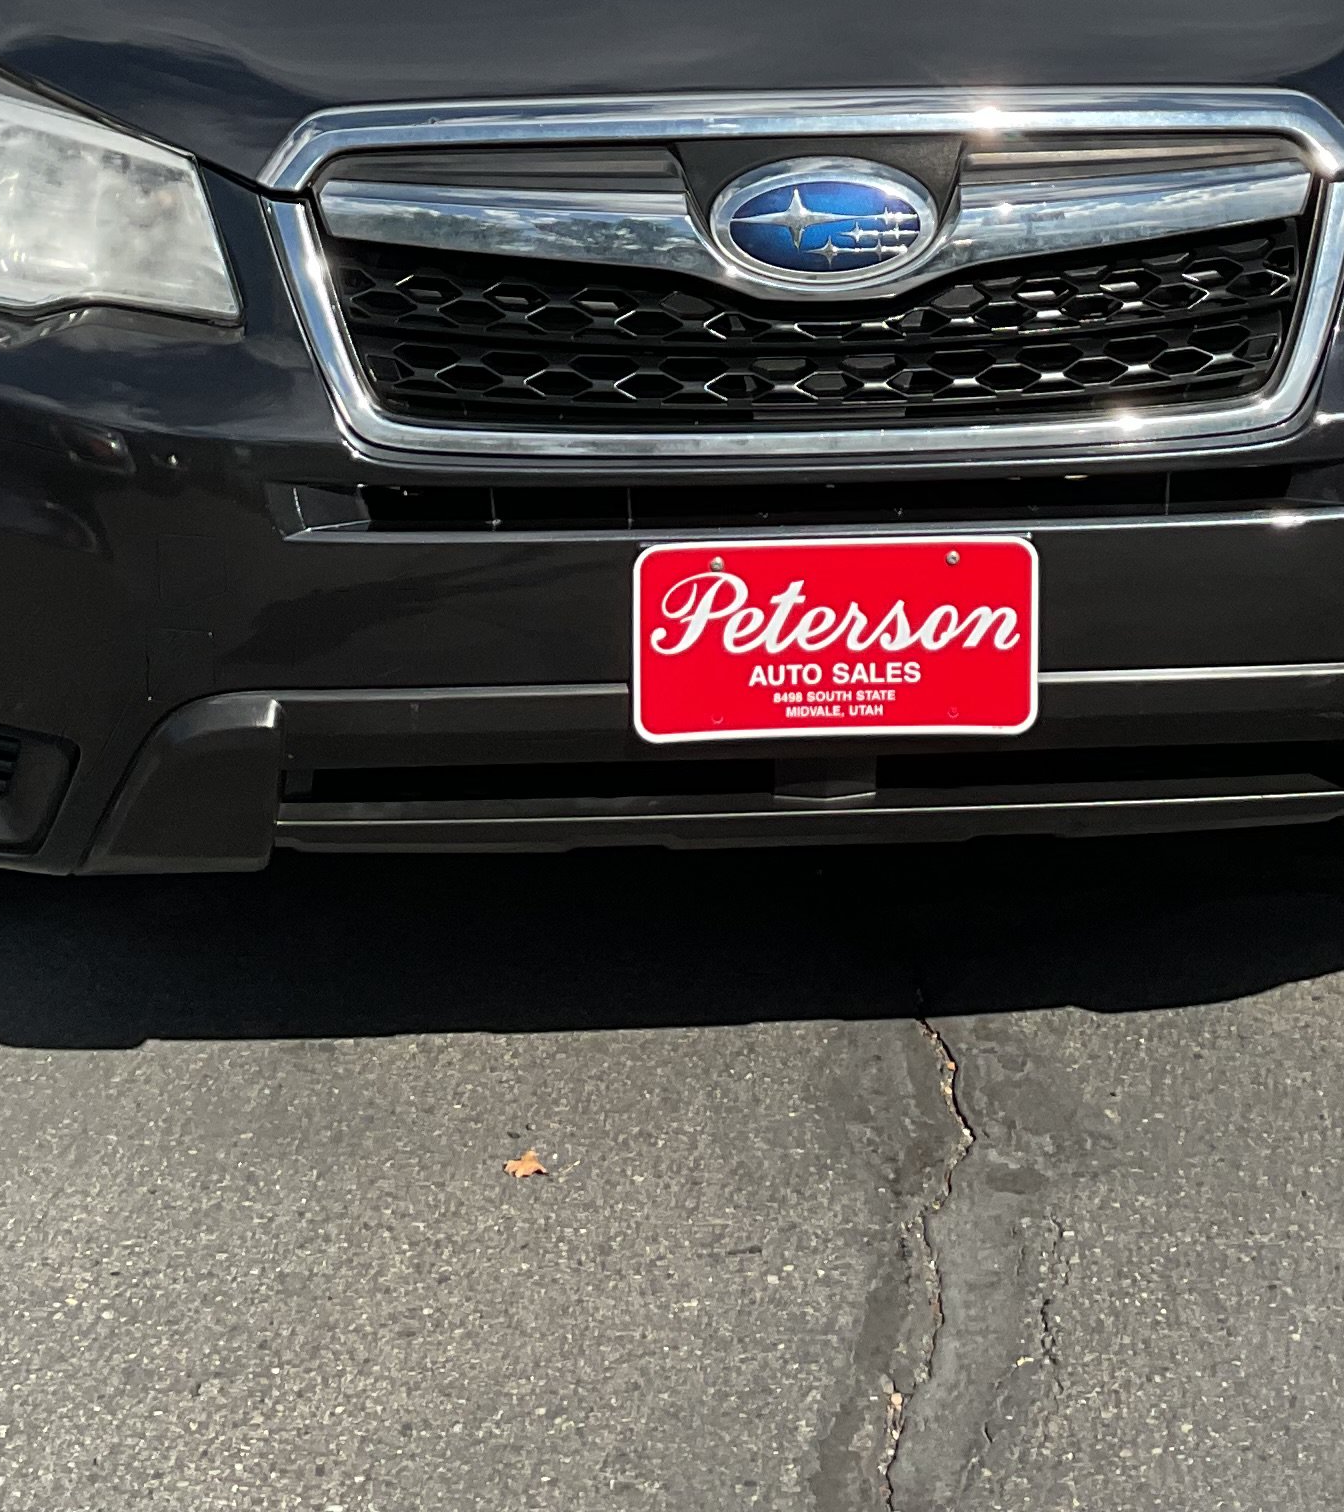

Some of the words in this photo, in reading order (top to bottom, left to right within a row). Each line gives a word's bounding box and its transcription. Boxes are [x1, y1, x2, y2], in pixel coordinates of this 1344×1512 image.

[650, 572, 1021, 655] Peterson
[748, 663, 823, 686] AUTO
[832, 661, 922, 684] SALES
[773, 690, 803, 704] 8498
[806, 690, 853, 703] SOUTH
[856, 689, 897, 702] STATE
[786, 704, 845, 718] MIDVALE,
[849, 704, 884, 717] UTAH
